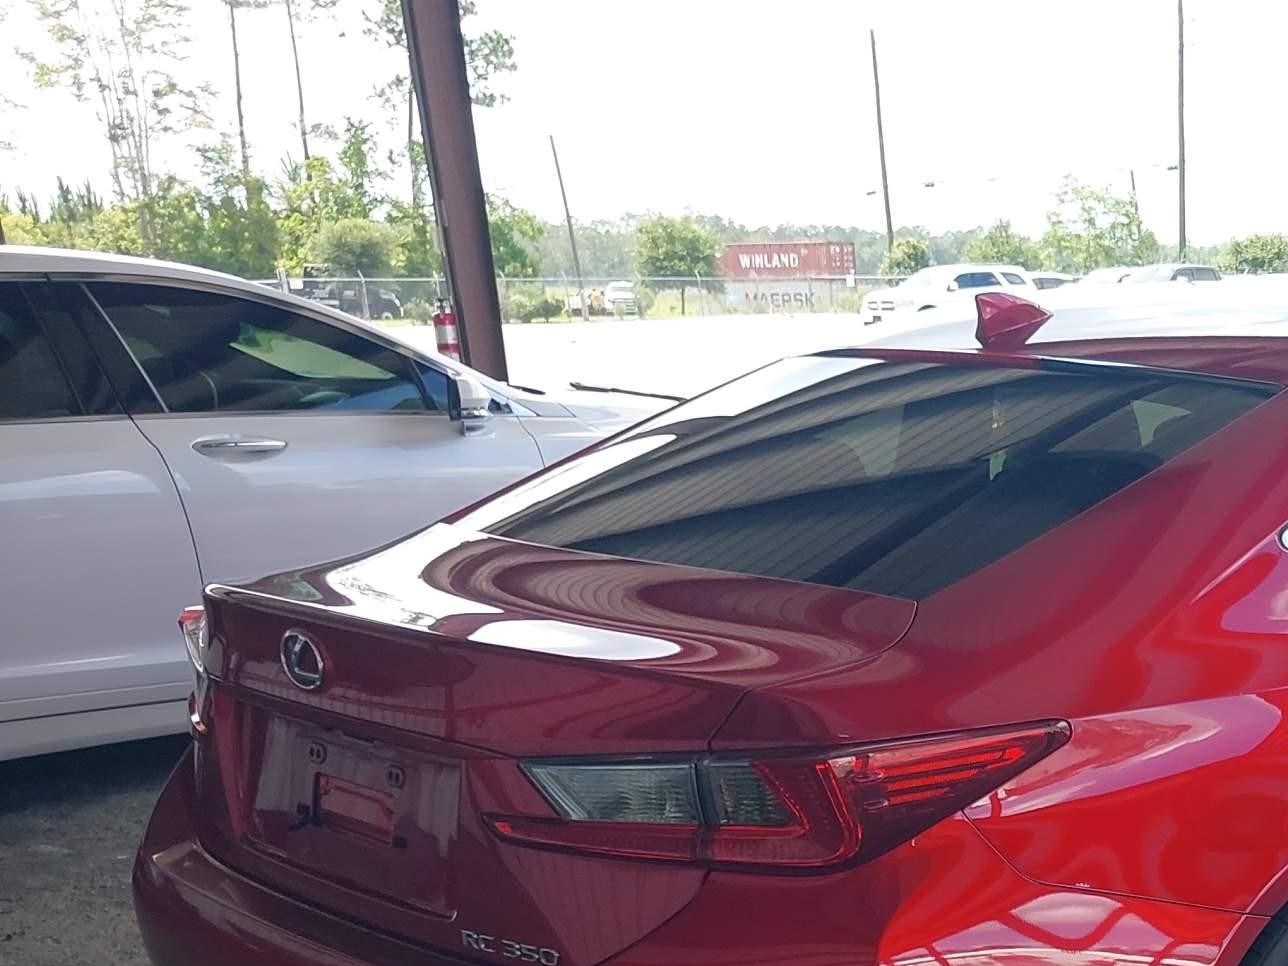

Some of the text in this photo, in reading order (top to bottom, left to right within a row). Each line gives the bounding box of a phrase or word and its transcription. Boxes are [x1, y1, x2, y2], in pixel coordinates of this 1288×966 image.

[738, 252, 799, 269] WINLAND
[461, 929, 560, 966] RC 350
